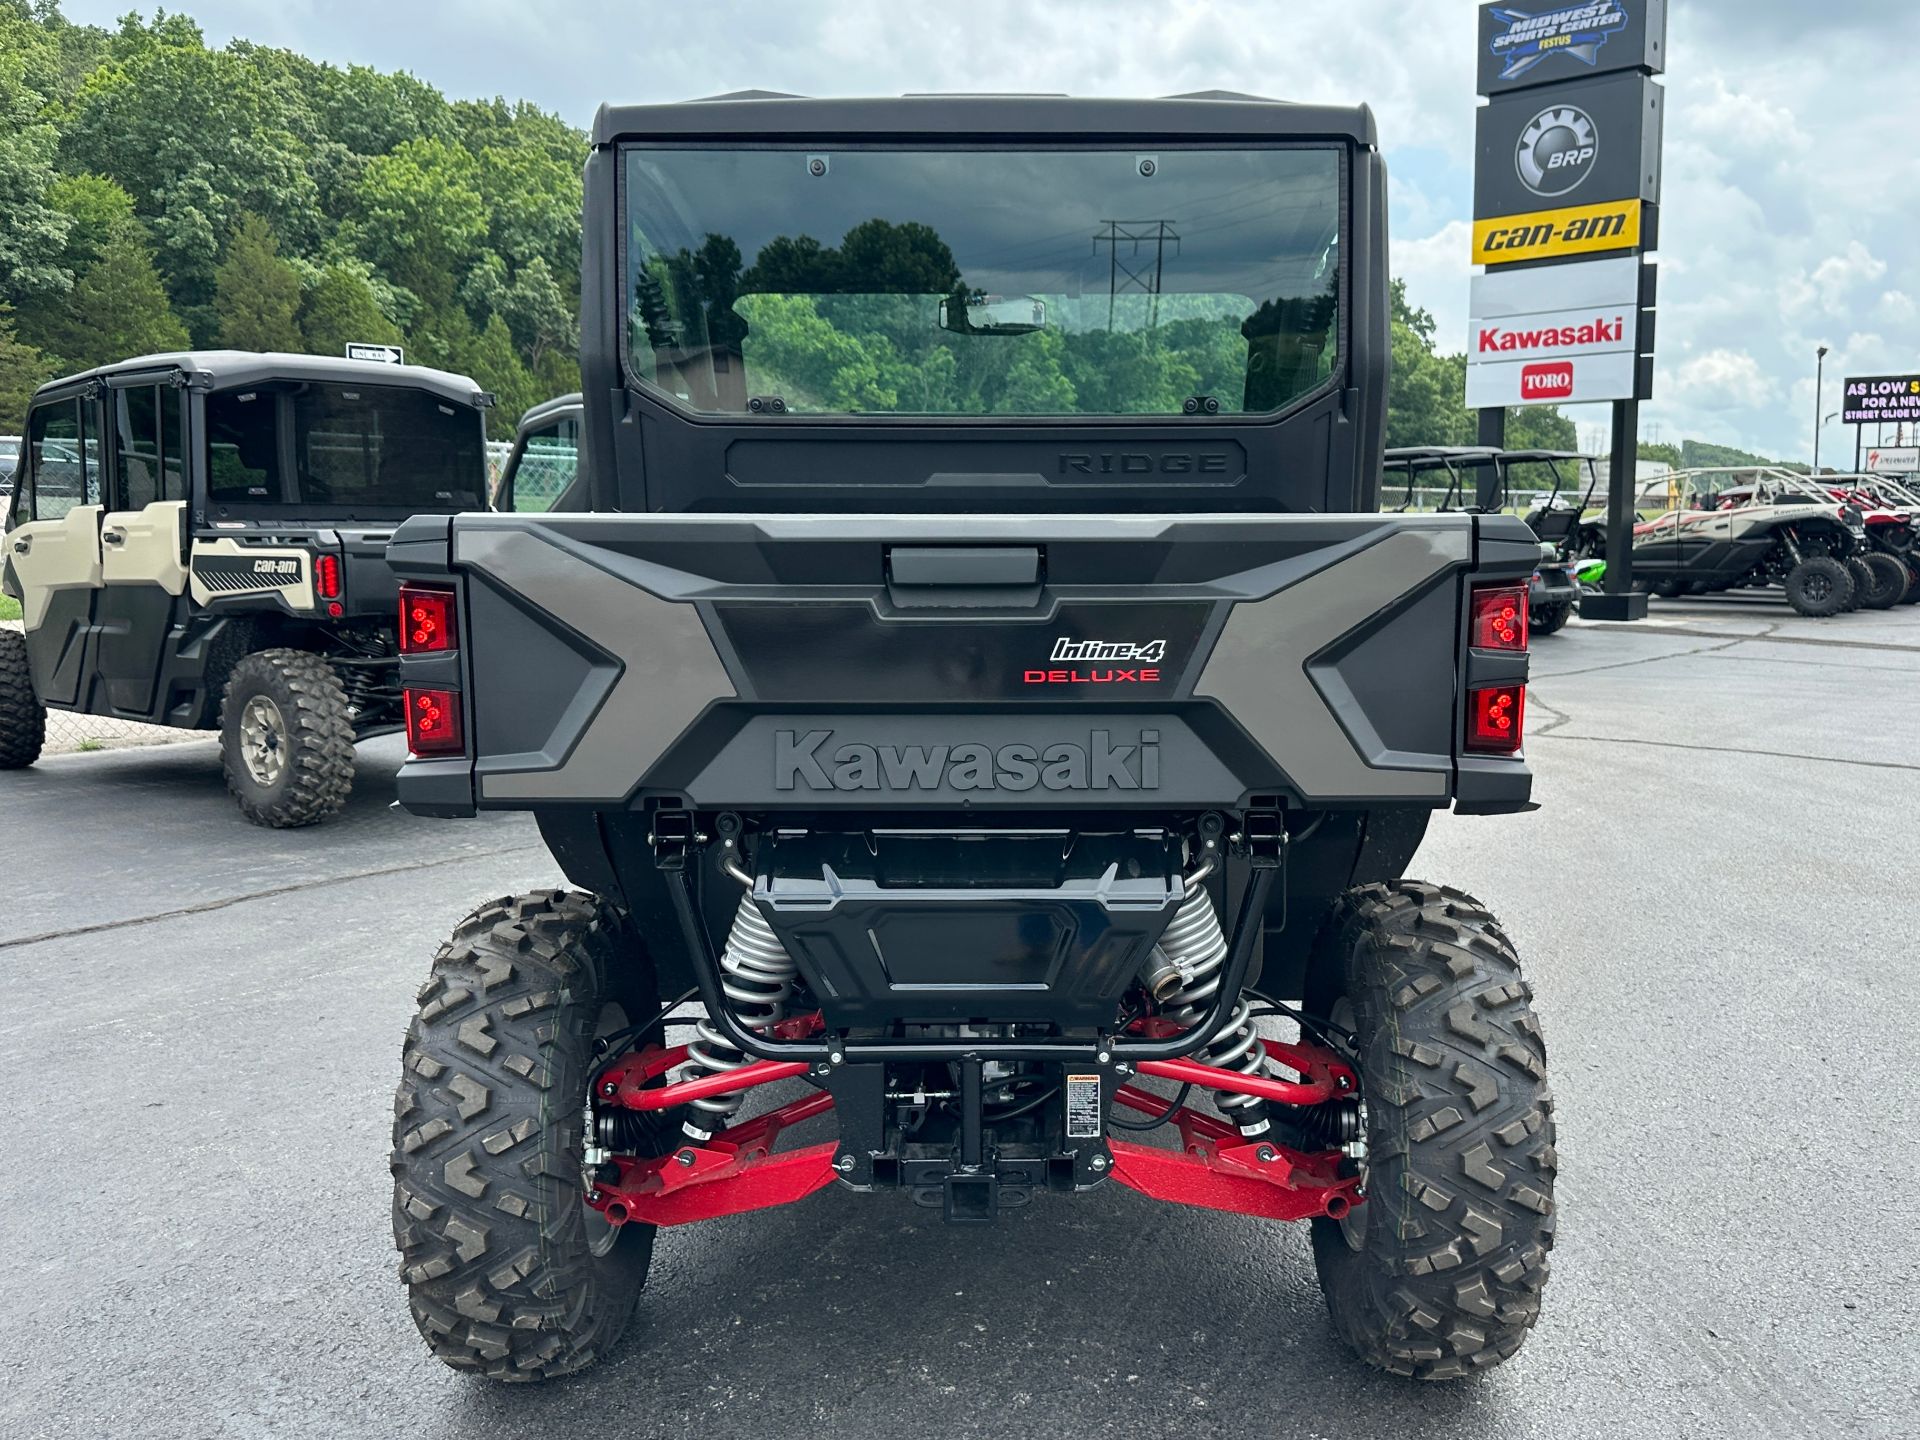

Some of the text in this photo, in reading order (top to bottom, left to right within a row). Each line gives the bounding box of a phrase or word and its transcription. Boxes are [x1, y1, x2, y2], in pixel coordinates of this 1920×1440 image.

[1509, 2, 1613, 34] MIDWEST
[1493, 11, 1622, 48] SPORTS CENTER
[1538, 34, 1572, 50] FESTUS
[1547, 146, 1594, 169] BRP
[1483, 212, 1627, 252] can-am
[1479, 316, 1623, 353] Kawasaki
[354, 351, 368, 359] ONE
[1524, 371, 1570, 390] TORO
[1847, 383, 1867, 396] AS
[1871, 381, 1907, 395] LOW
[1862, 397, 1887, 409] FOR
[1888, 396, 1898, 408] A
[1845, 410, 1880, 420] STREET
[1881, 408, 1910, 419] GLIDE
[1059, 453, 1229, 475] RIDGE
[253, 559, 297, 574] can-am
[1050, 637, 1166, 663] Inline-4
[1024, 669, 1161, 683] DELUXE
[774, 728, 1162, 791] Kawasaki
